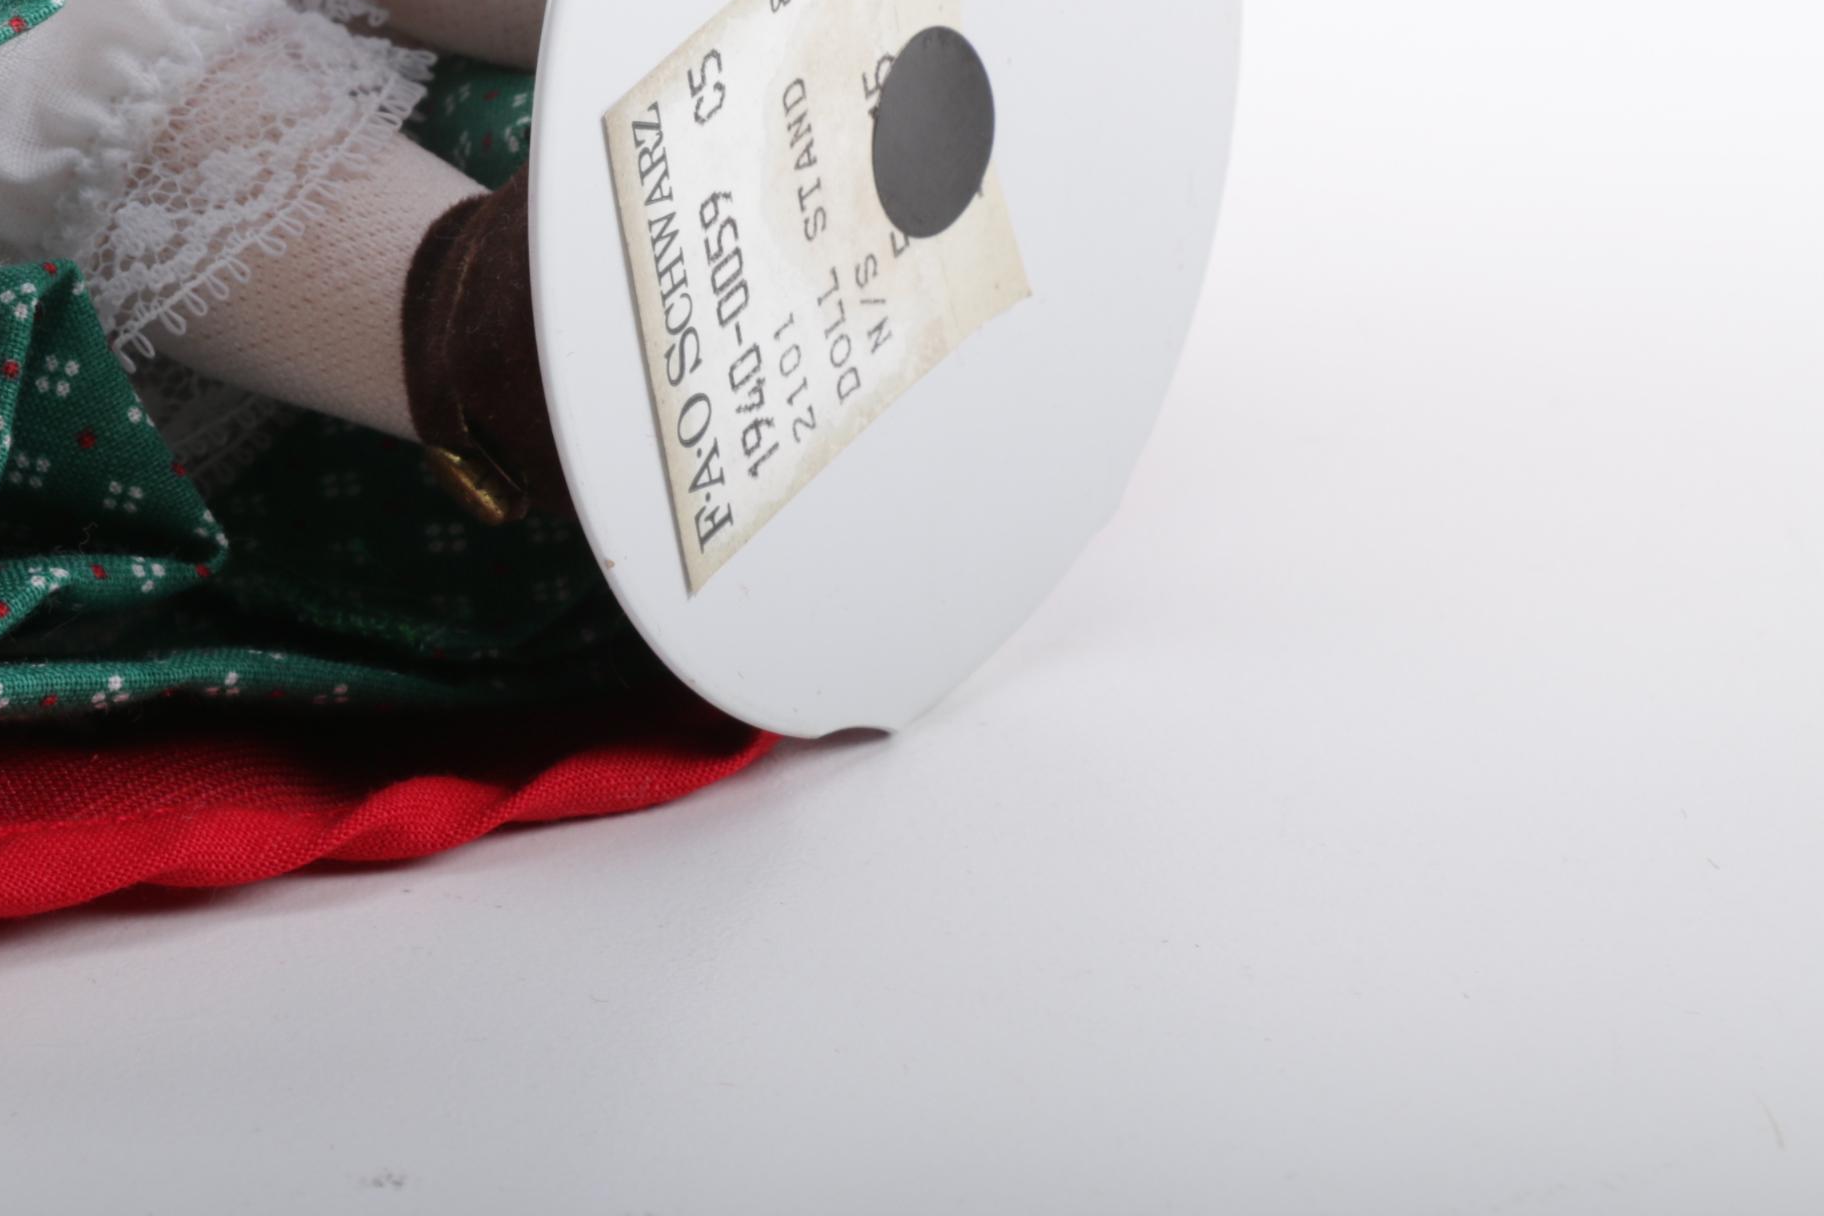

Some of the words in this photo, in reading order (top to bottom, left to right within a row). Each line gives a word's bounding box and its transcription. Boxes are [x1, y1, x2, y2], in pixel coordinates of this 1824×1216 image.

[687, 48, 726, 126] C5
[782, 77, 828, 242] STAND
[631, 100, 703, 388] SCHWARZ
[854, 252, 894, 355] N/S
[698, 189, 780, 478] 1940-0059
[773, 311, 817, 444] 2101
[816, 266, 862, 405] DOLL
